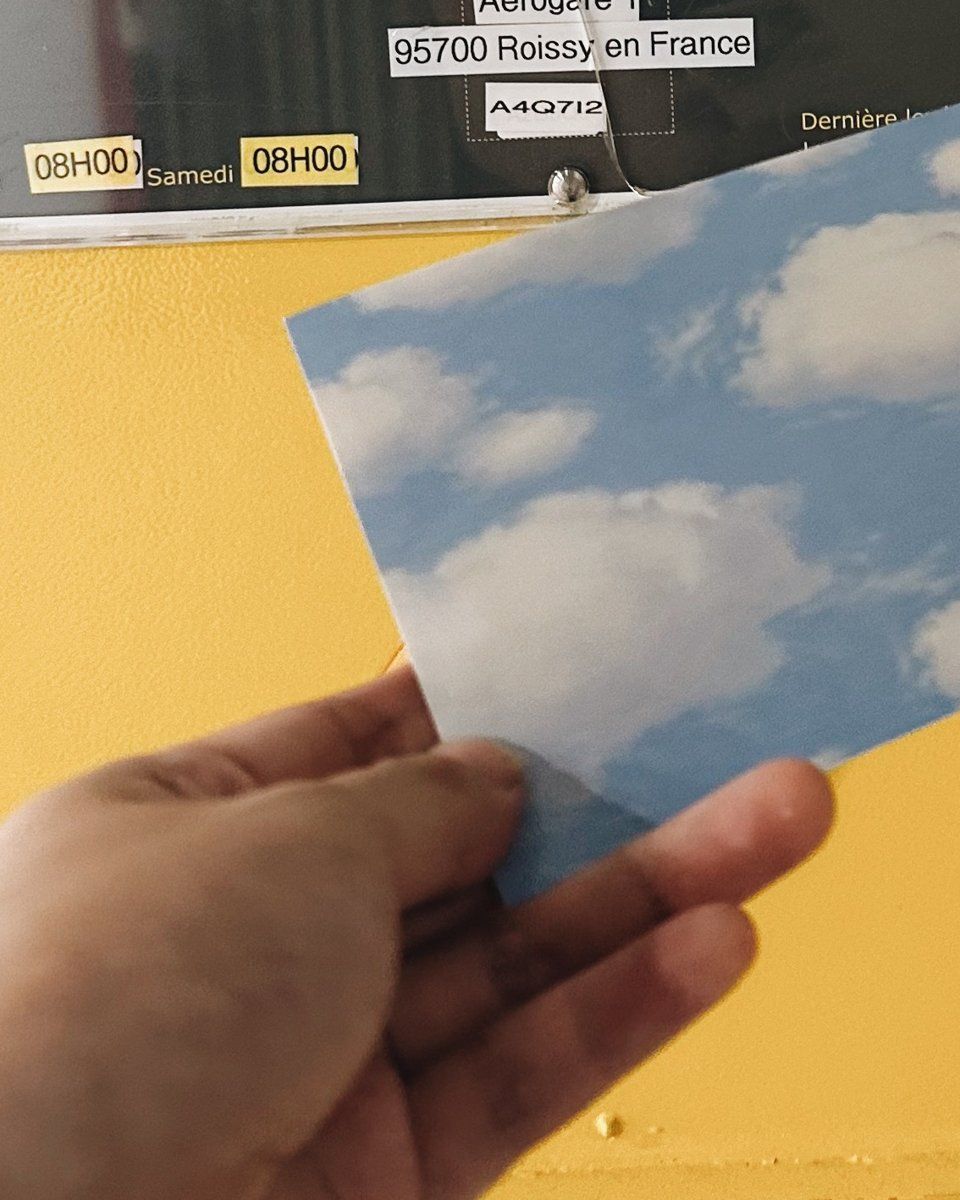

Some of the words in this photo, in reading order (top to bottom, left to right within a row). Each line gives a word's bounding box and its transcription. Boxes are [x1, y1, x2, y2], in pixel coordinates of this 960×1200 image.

[394, 35, 488, 65] 95700
[498, 34, 594, 63] Roissy
[604, 38, 640, 57] en
[650, 31, 751, 56] France
[801, 108, 897, 131] Dernière
[35, 147, 129, 181] 08H00
[147, 164, 233, 187] Samedi
[252, 144, 348, 175] 08H00
